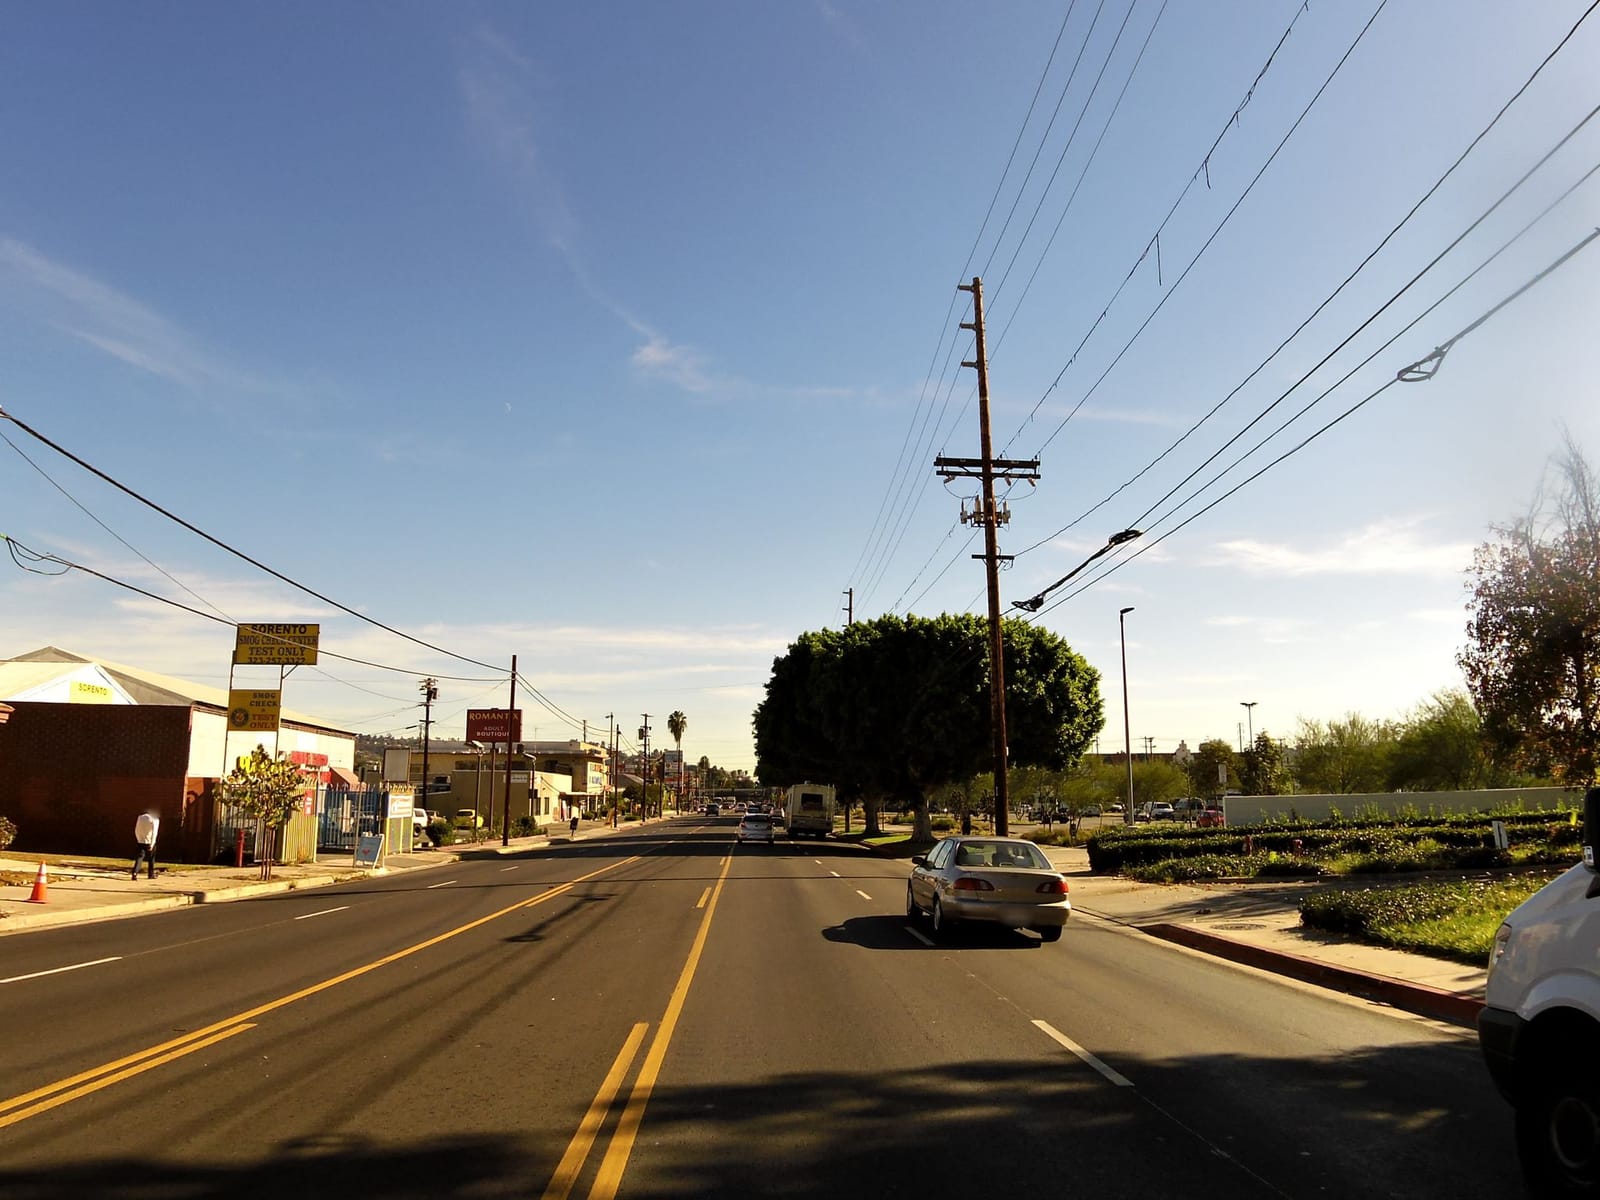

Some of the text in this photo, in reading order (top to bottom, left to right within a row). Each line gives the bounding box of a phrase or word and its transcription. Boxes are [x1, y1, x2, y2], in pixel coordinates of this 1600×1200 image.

[251, 624, 307, 634] SORENTO
[239, 636, 260, 645] SMOG
[249, 646, 306, 656] TEST ONLY
[78, 683, 107, 695] SORENTO
[469, 712, 519, 721] ROMANTX
